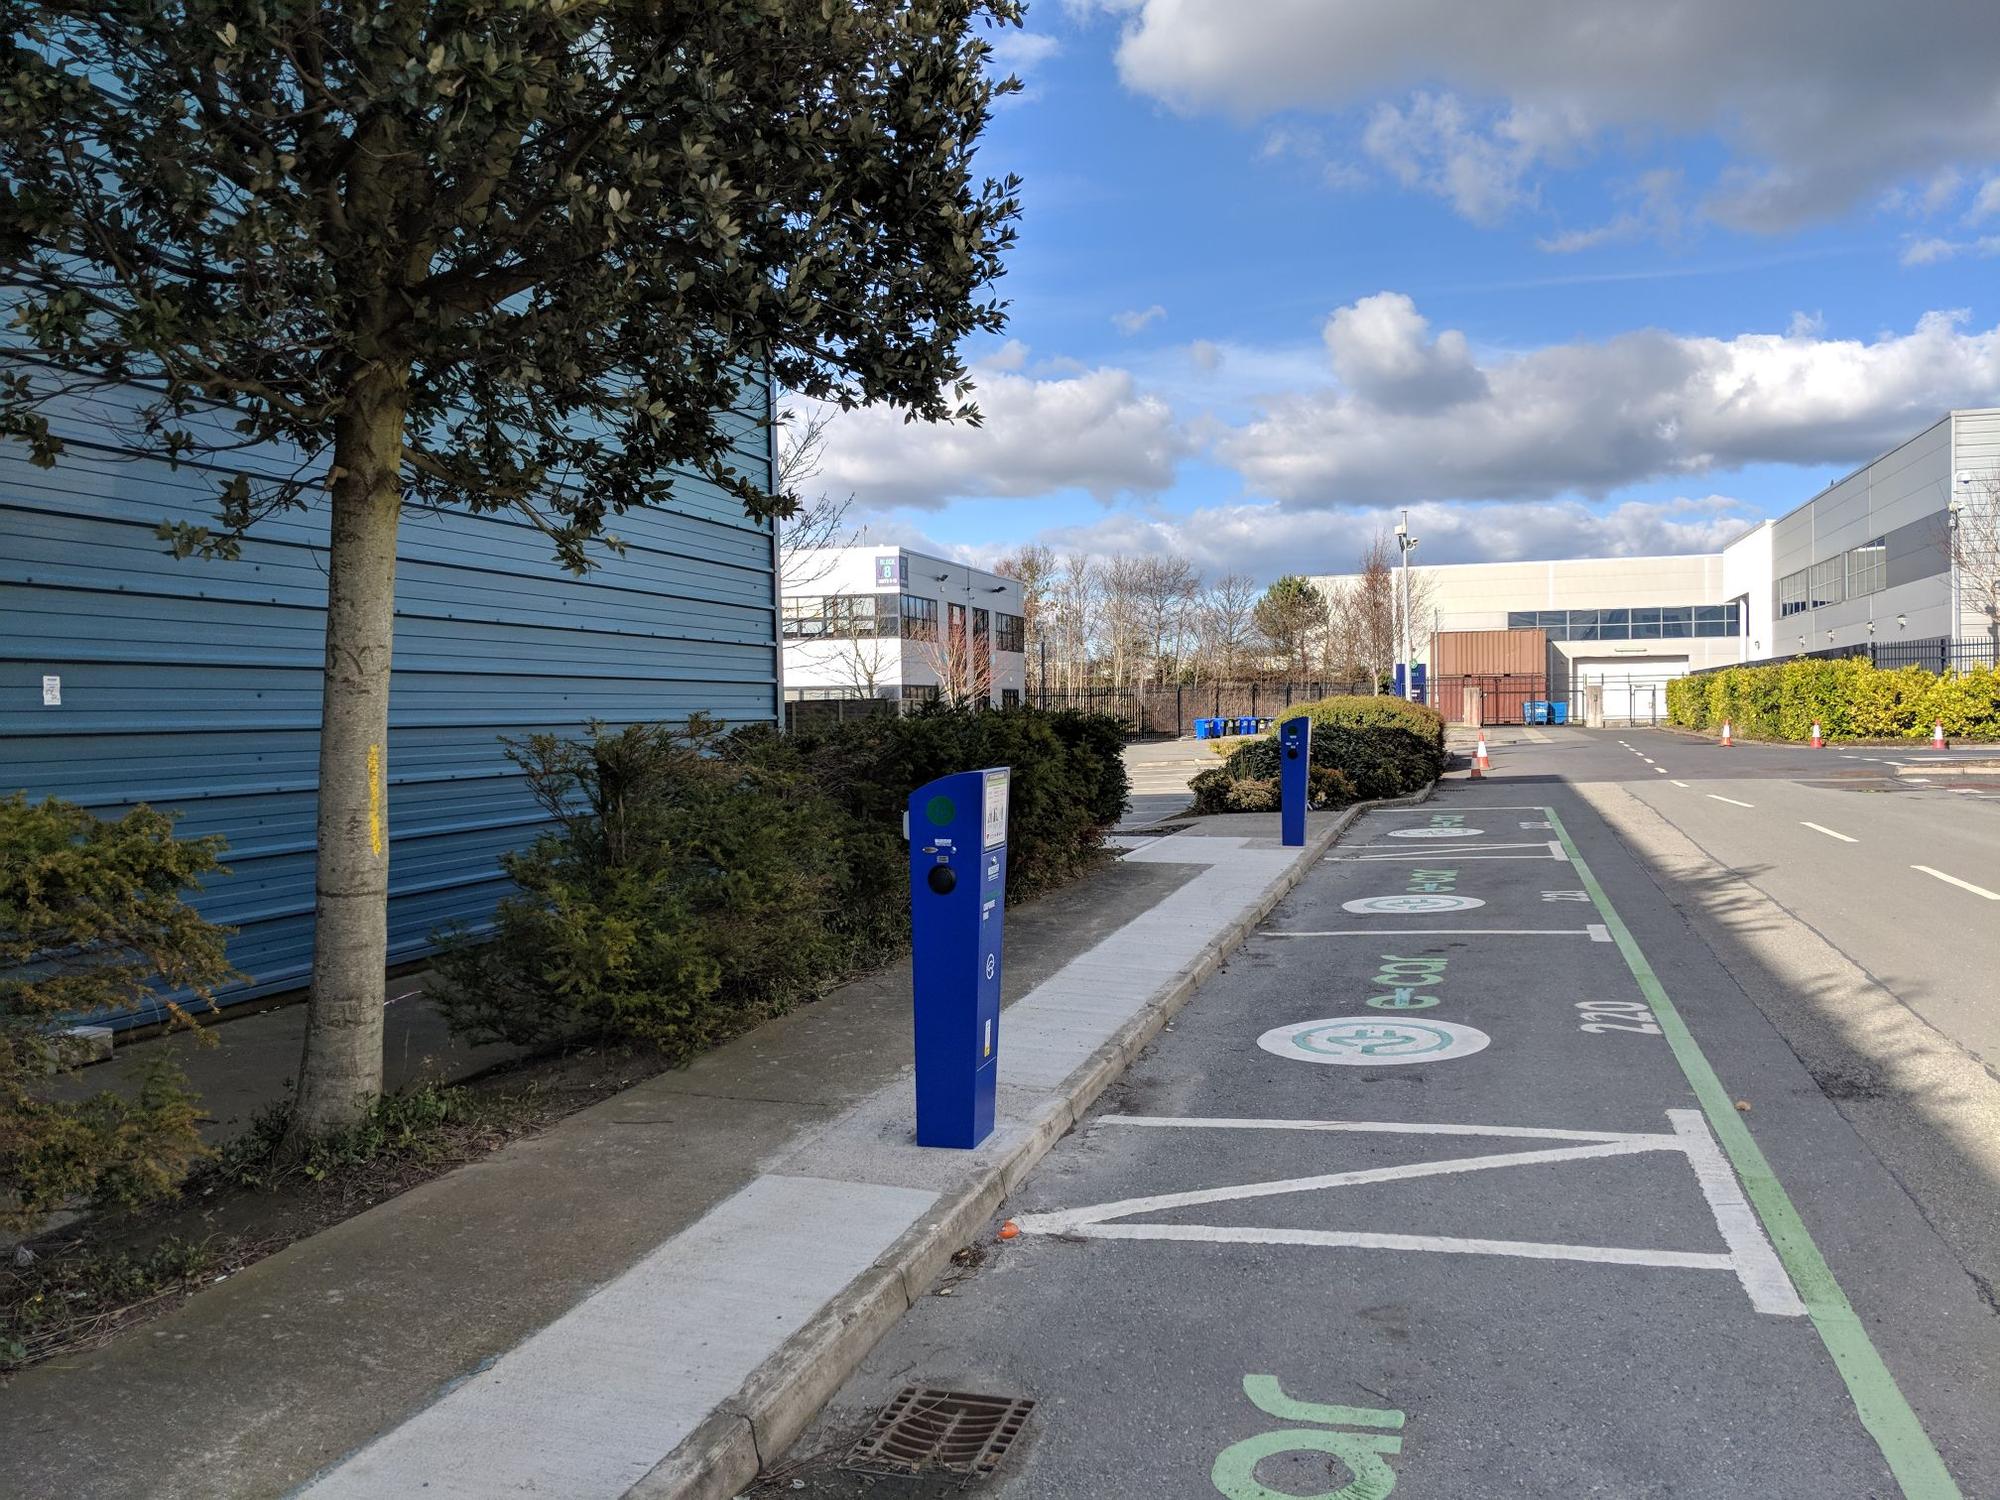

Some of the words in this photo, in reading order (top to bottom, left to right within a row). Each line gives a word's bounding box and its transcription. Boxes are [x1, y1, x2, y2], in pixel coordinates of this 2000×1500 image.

[884, 566, 892, 578] 8
[1540, 890, 1591, 903] 221
[1366, 954, 1449, 1009] e-car
[1574, 1000, 1663, 1035] 220
